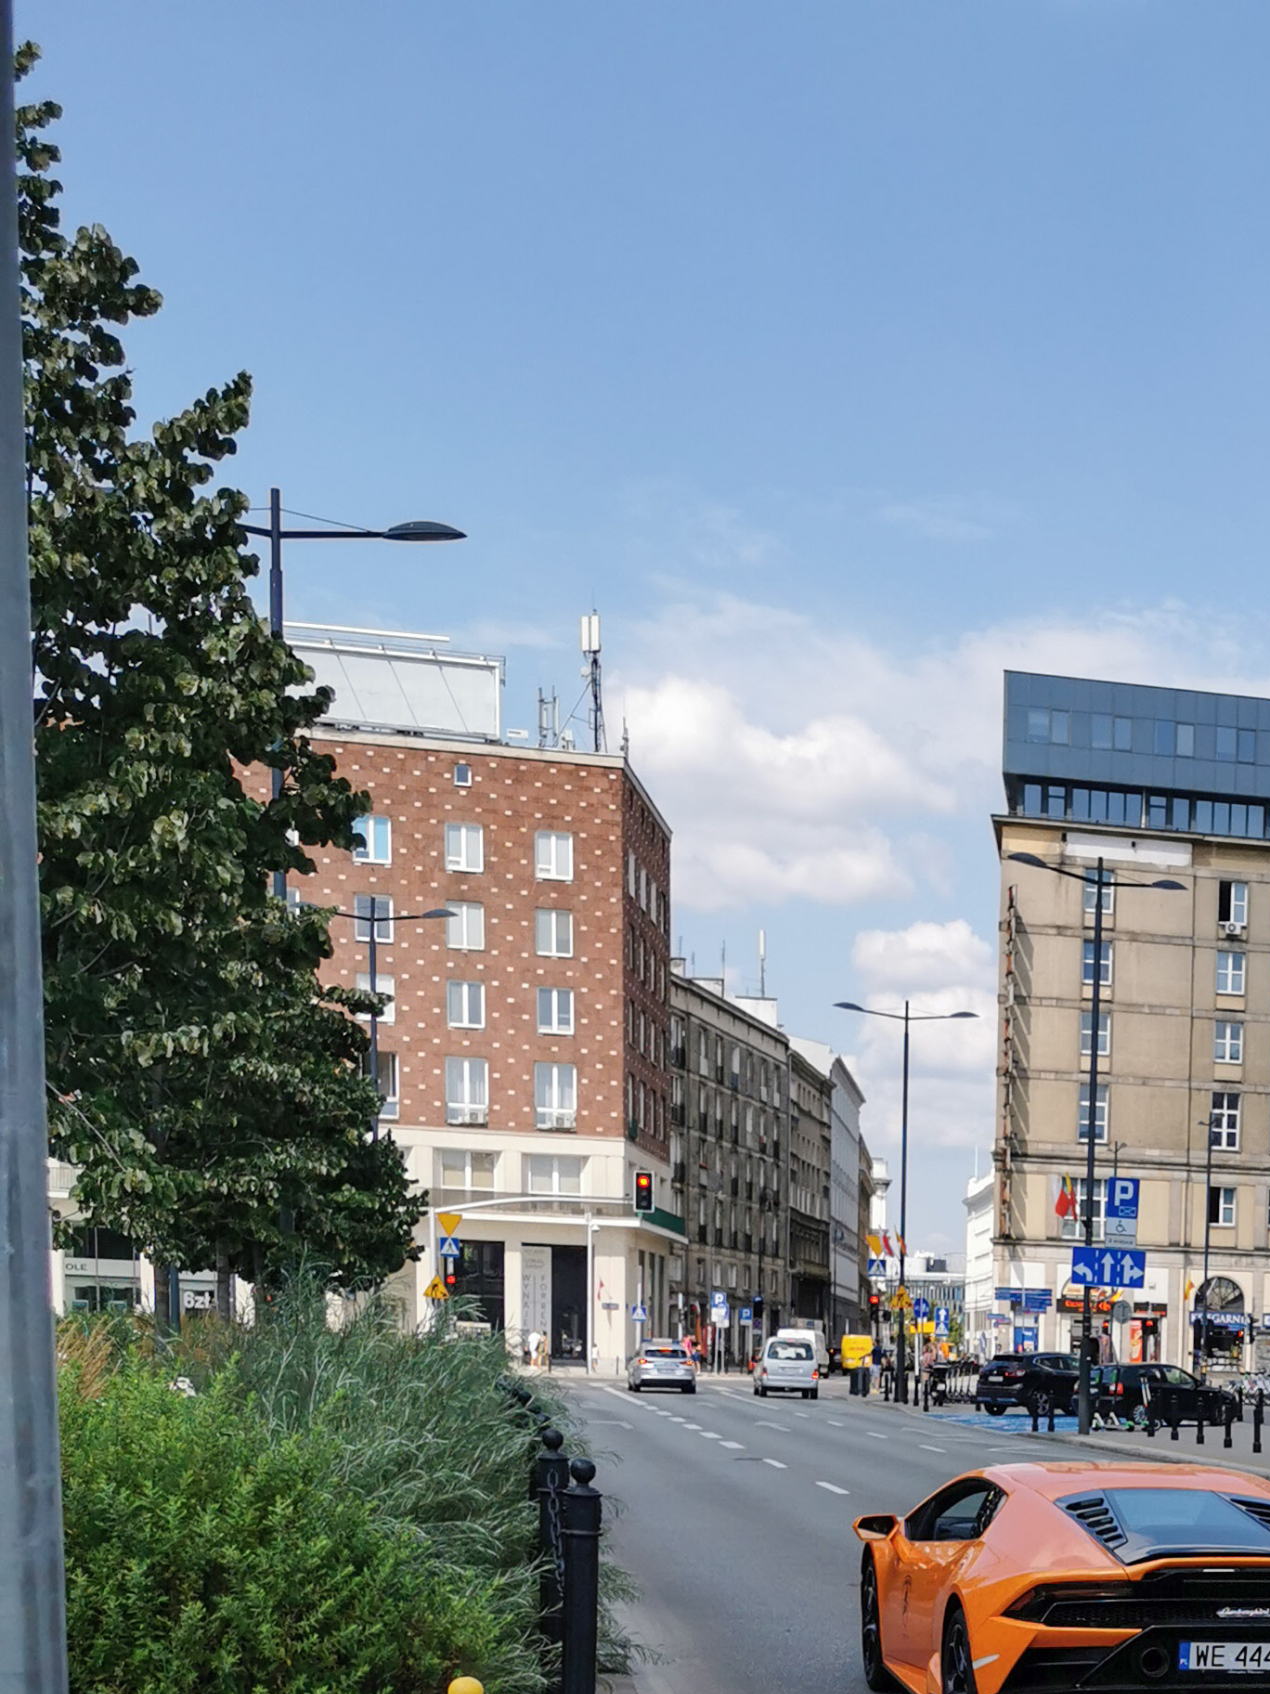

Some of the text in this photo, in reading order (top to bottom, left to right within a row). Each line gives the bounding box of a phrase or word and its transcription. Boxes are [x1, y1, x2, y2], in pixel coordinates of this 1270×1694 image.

[1114, 1180, 1134, 1206] P
[183, 1291, 211, 1309] 6zł
[715, 1293, 724, 1305] P
[742, 1308, 751, 1318] P
[1190, 1312, 1251, 1325] KSGARNIA
[1196, 1645, 1226, 1667] WE
